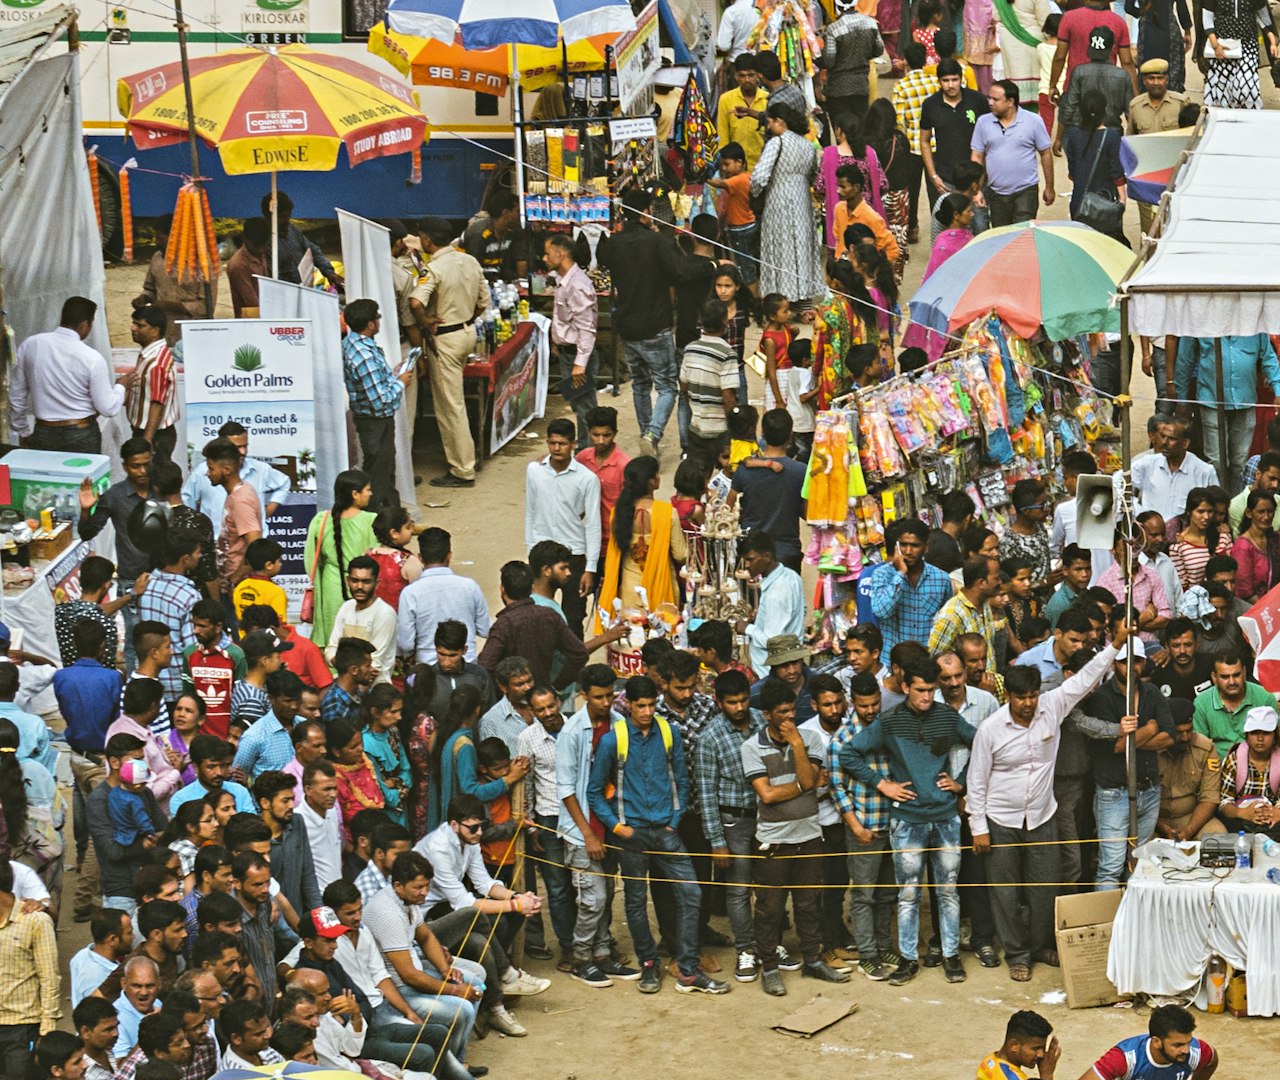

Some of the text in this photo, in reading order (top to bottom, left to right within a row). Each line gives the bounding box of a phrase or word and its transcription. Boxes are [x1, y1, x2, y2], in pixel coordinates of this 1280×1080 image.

[245, 13, 306, 24] KIRLOSKAR
[246, 33, 306, 44] GREEN
[429, 66, 470, 82] 98.3
[353, 127, 412, 155] STUDY ABROAD
[270, 327, 304, 336] UBBER
[204, 373, 293, 388] Golden Palms
[203, 415, 223, 425] 100
[255, 414, 287, 424] Gated
[290, 414, 298, 423] &
[287, 527, 308, 536] LACS
[193, 669, 231, 678] adidas
